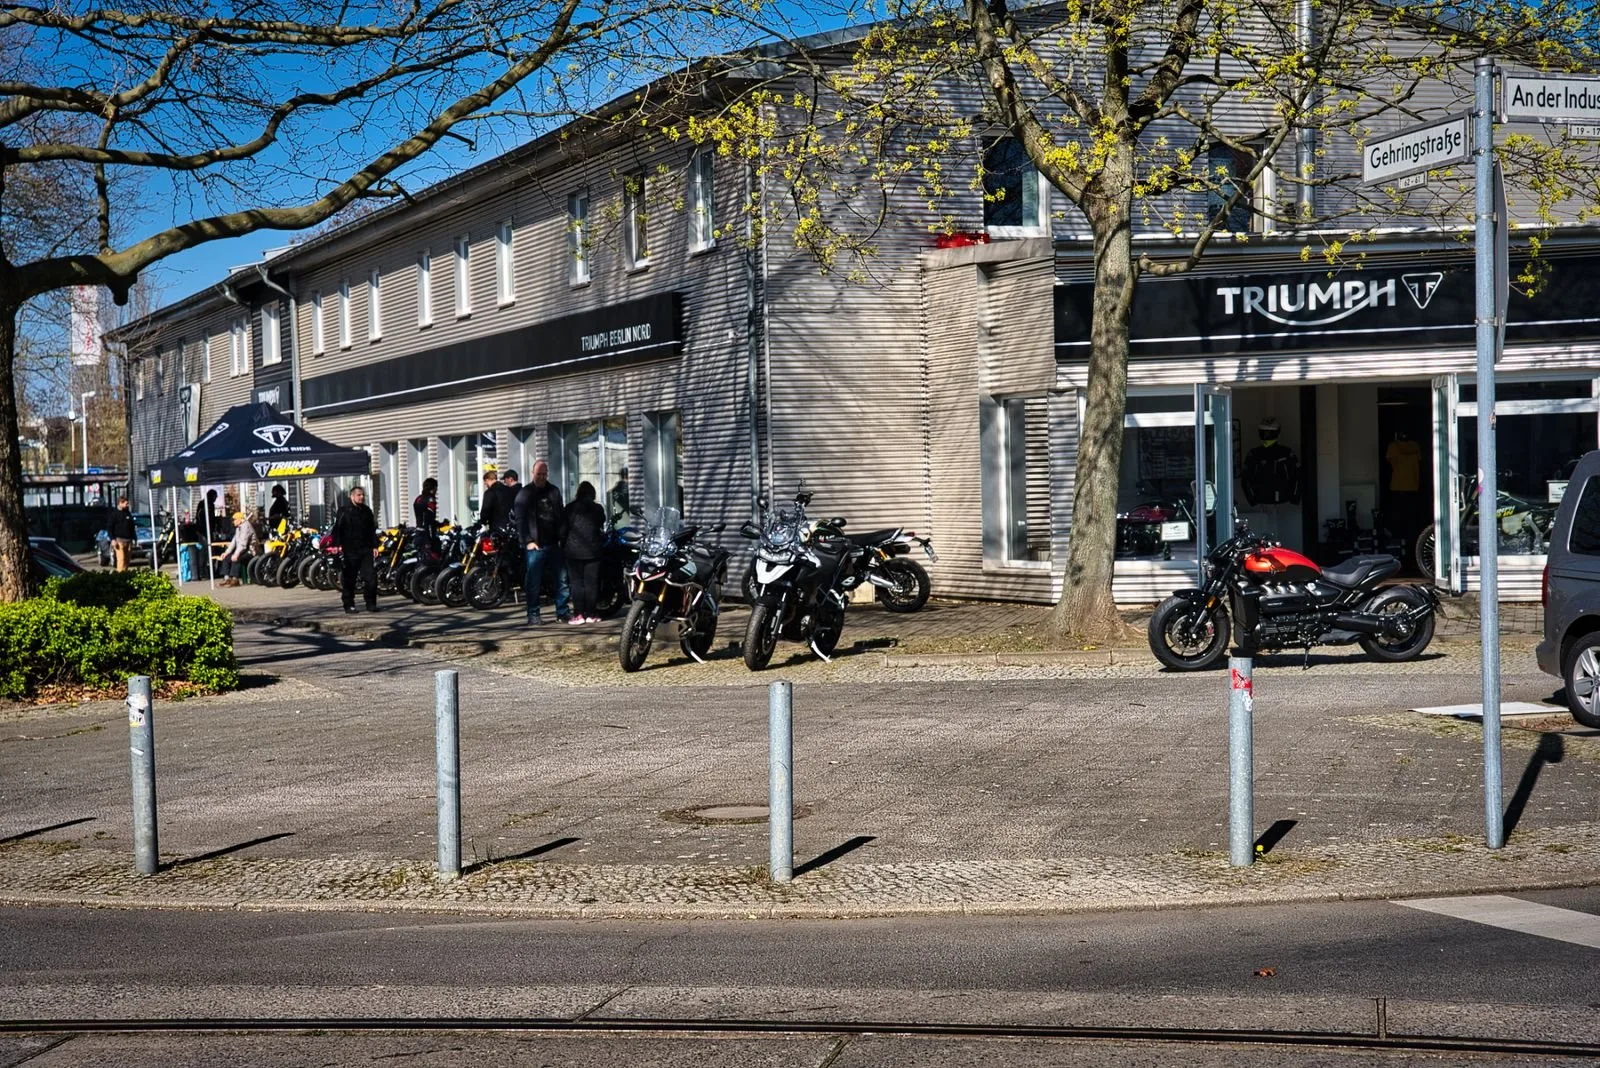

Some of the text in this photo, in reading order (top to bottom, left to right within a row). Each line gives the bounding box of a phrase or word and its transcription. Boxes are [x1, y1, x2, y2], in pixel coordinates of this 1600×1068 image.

[1512, 84, 1533, 107] An
[1537, 85, 1562, 108] der
[1370, 127, 1462, 169] Gehringstraße
[1216, 278, 1396, 326] TRIUMPH
[580, 323, 652, 351] TRIUMPH BERLIN NORD
[270, 459, 320, 471] TRIUMPH
